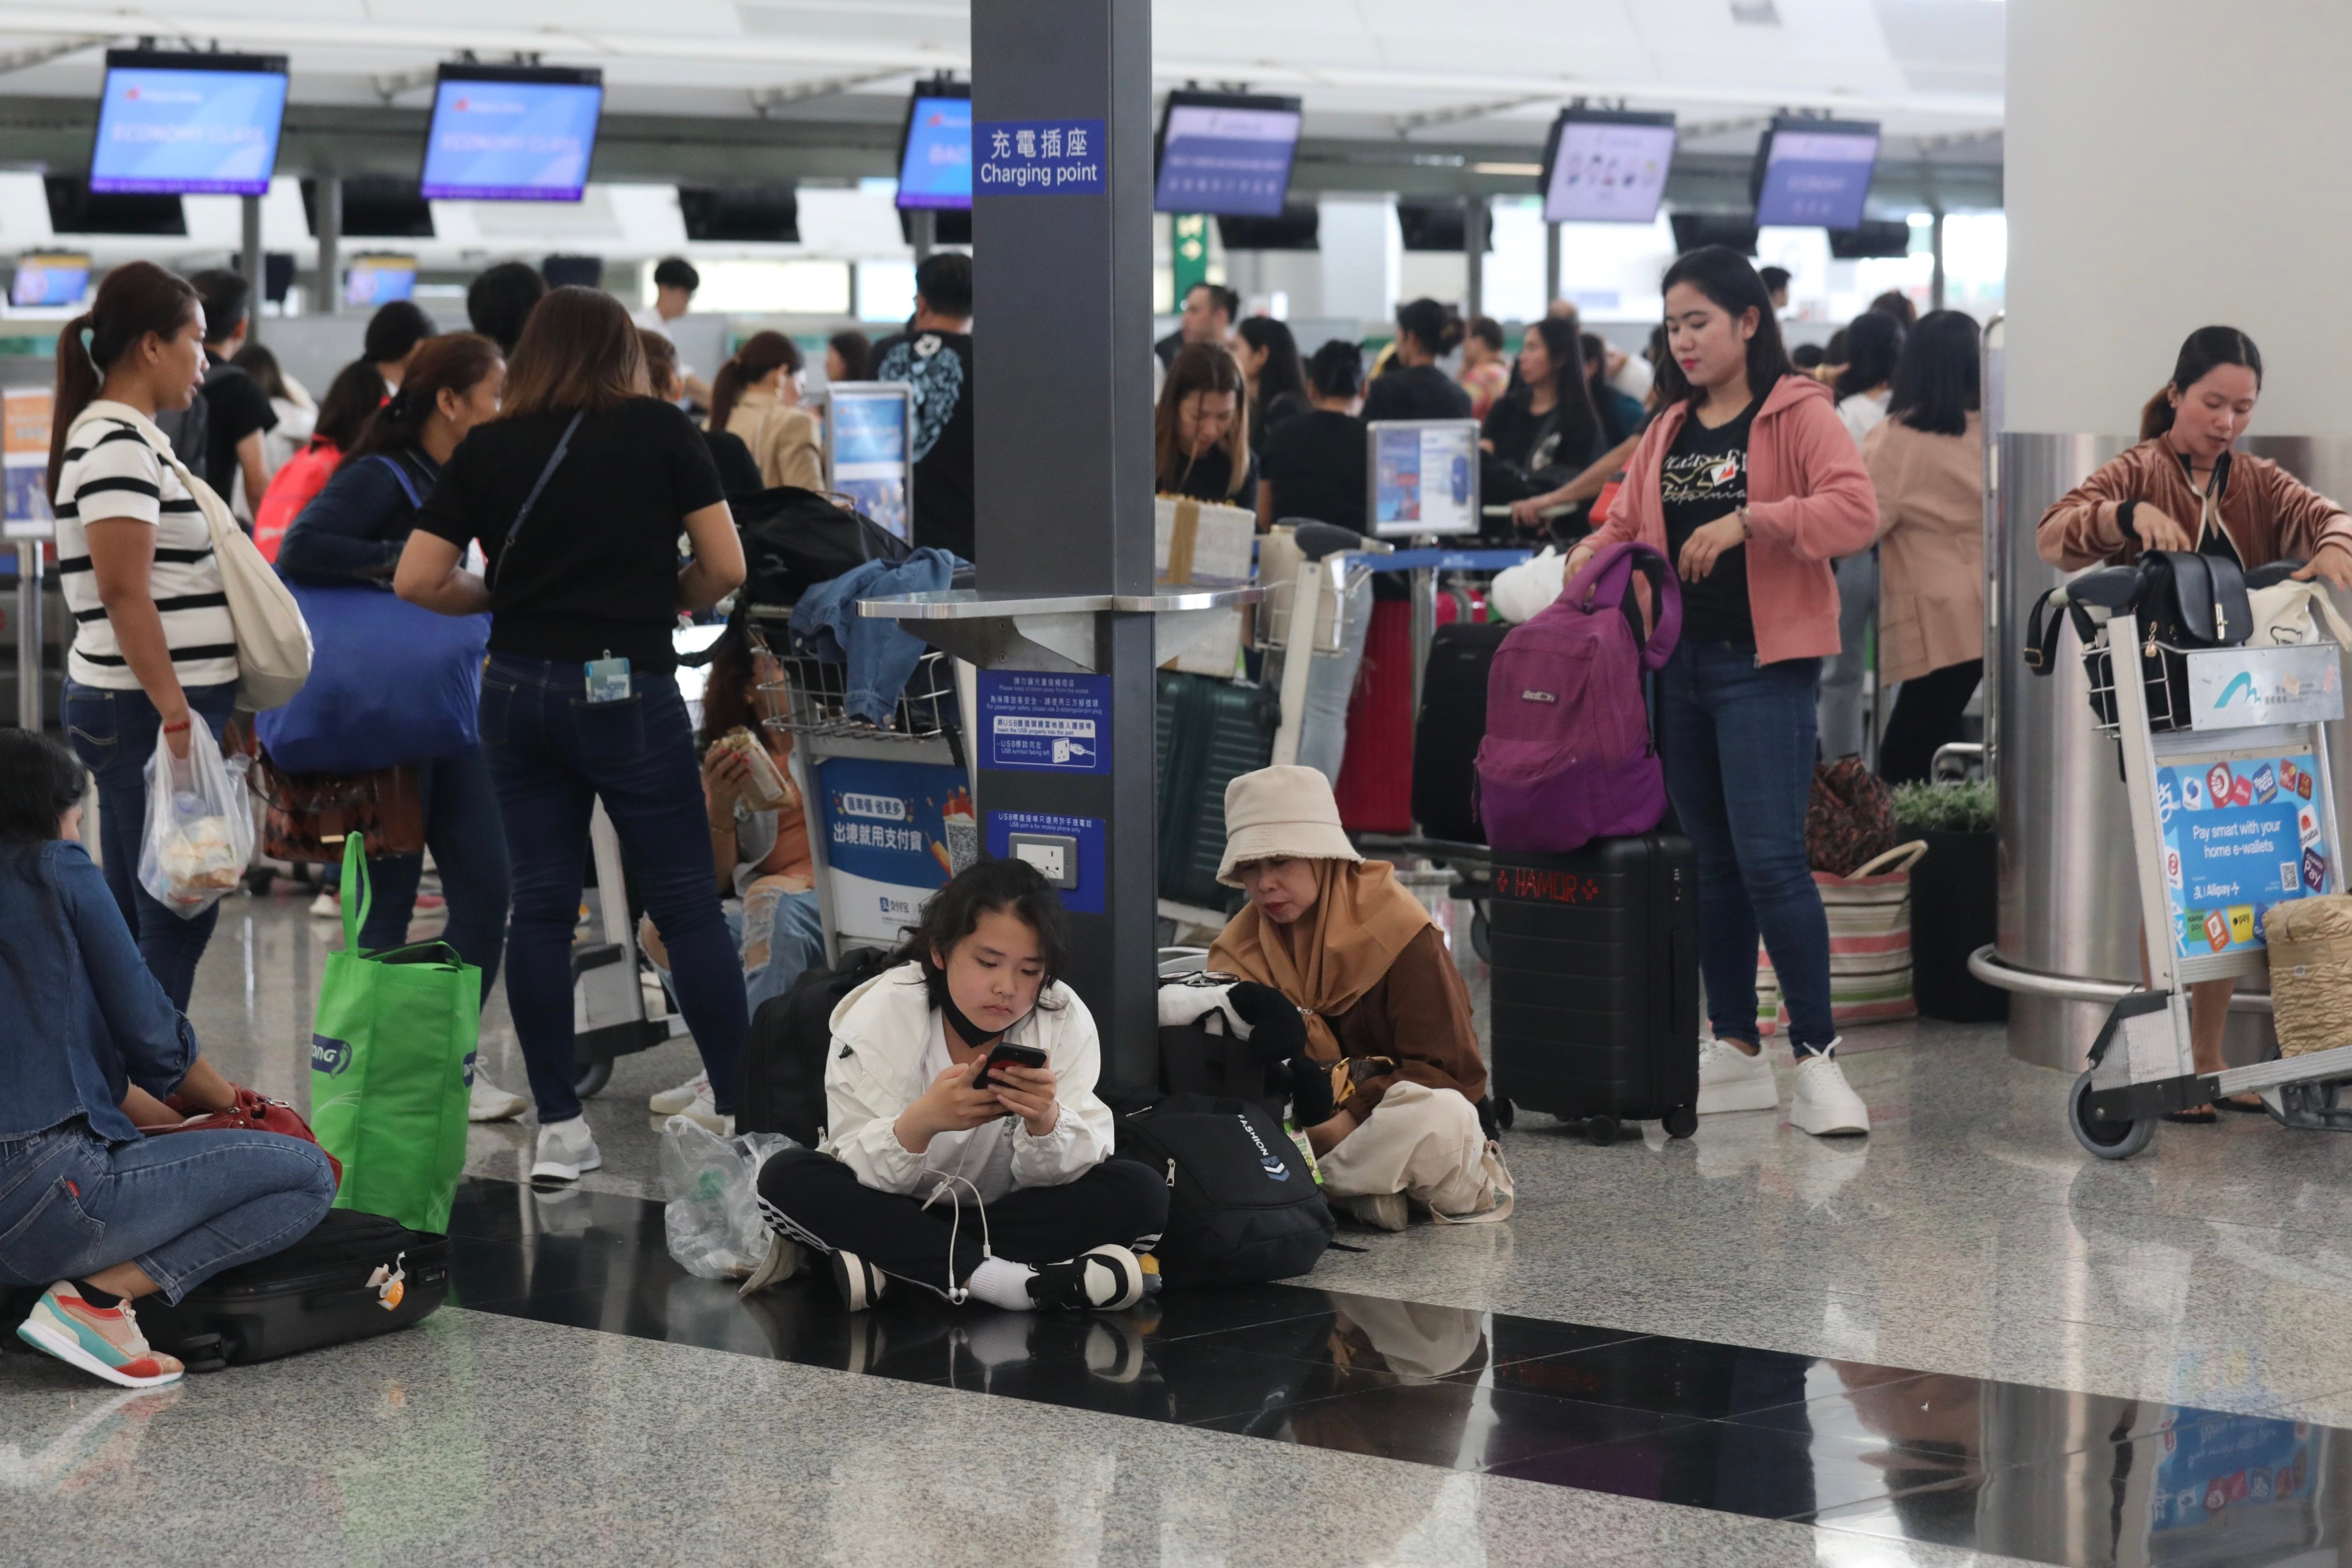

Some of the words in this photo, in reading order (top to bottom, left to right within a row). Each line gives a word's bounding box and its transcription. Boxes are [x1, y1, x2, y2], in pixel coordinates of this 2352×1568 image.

[991, 127, 1088, 159] 充電插座
[981, 162, 1051, 187] Charging
[1057, 162, 1097, 185] point
[994, 704, 1016, 713] passenger
[2192, 825, 2210, 842] Pay
[2211, 823, 2238, 838] smart
[2239, 820, 2260, 835] with
[2261, 820, 2281, 837] your
[2204, 845, 2231, 859] home
[2233, 839, 2274, 855] e-wallets
[2304, 860, 2322, 886] Pay
[2238, 913, 2250, 926] pay
[1237, 1114, 1268, 1156] FASHION
